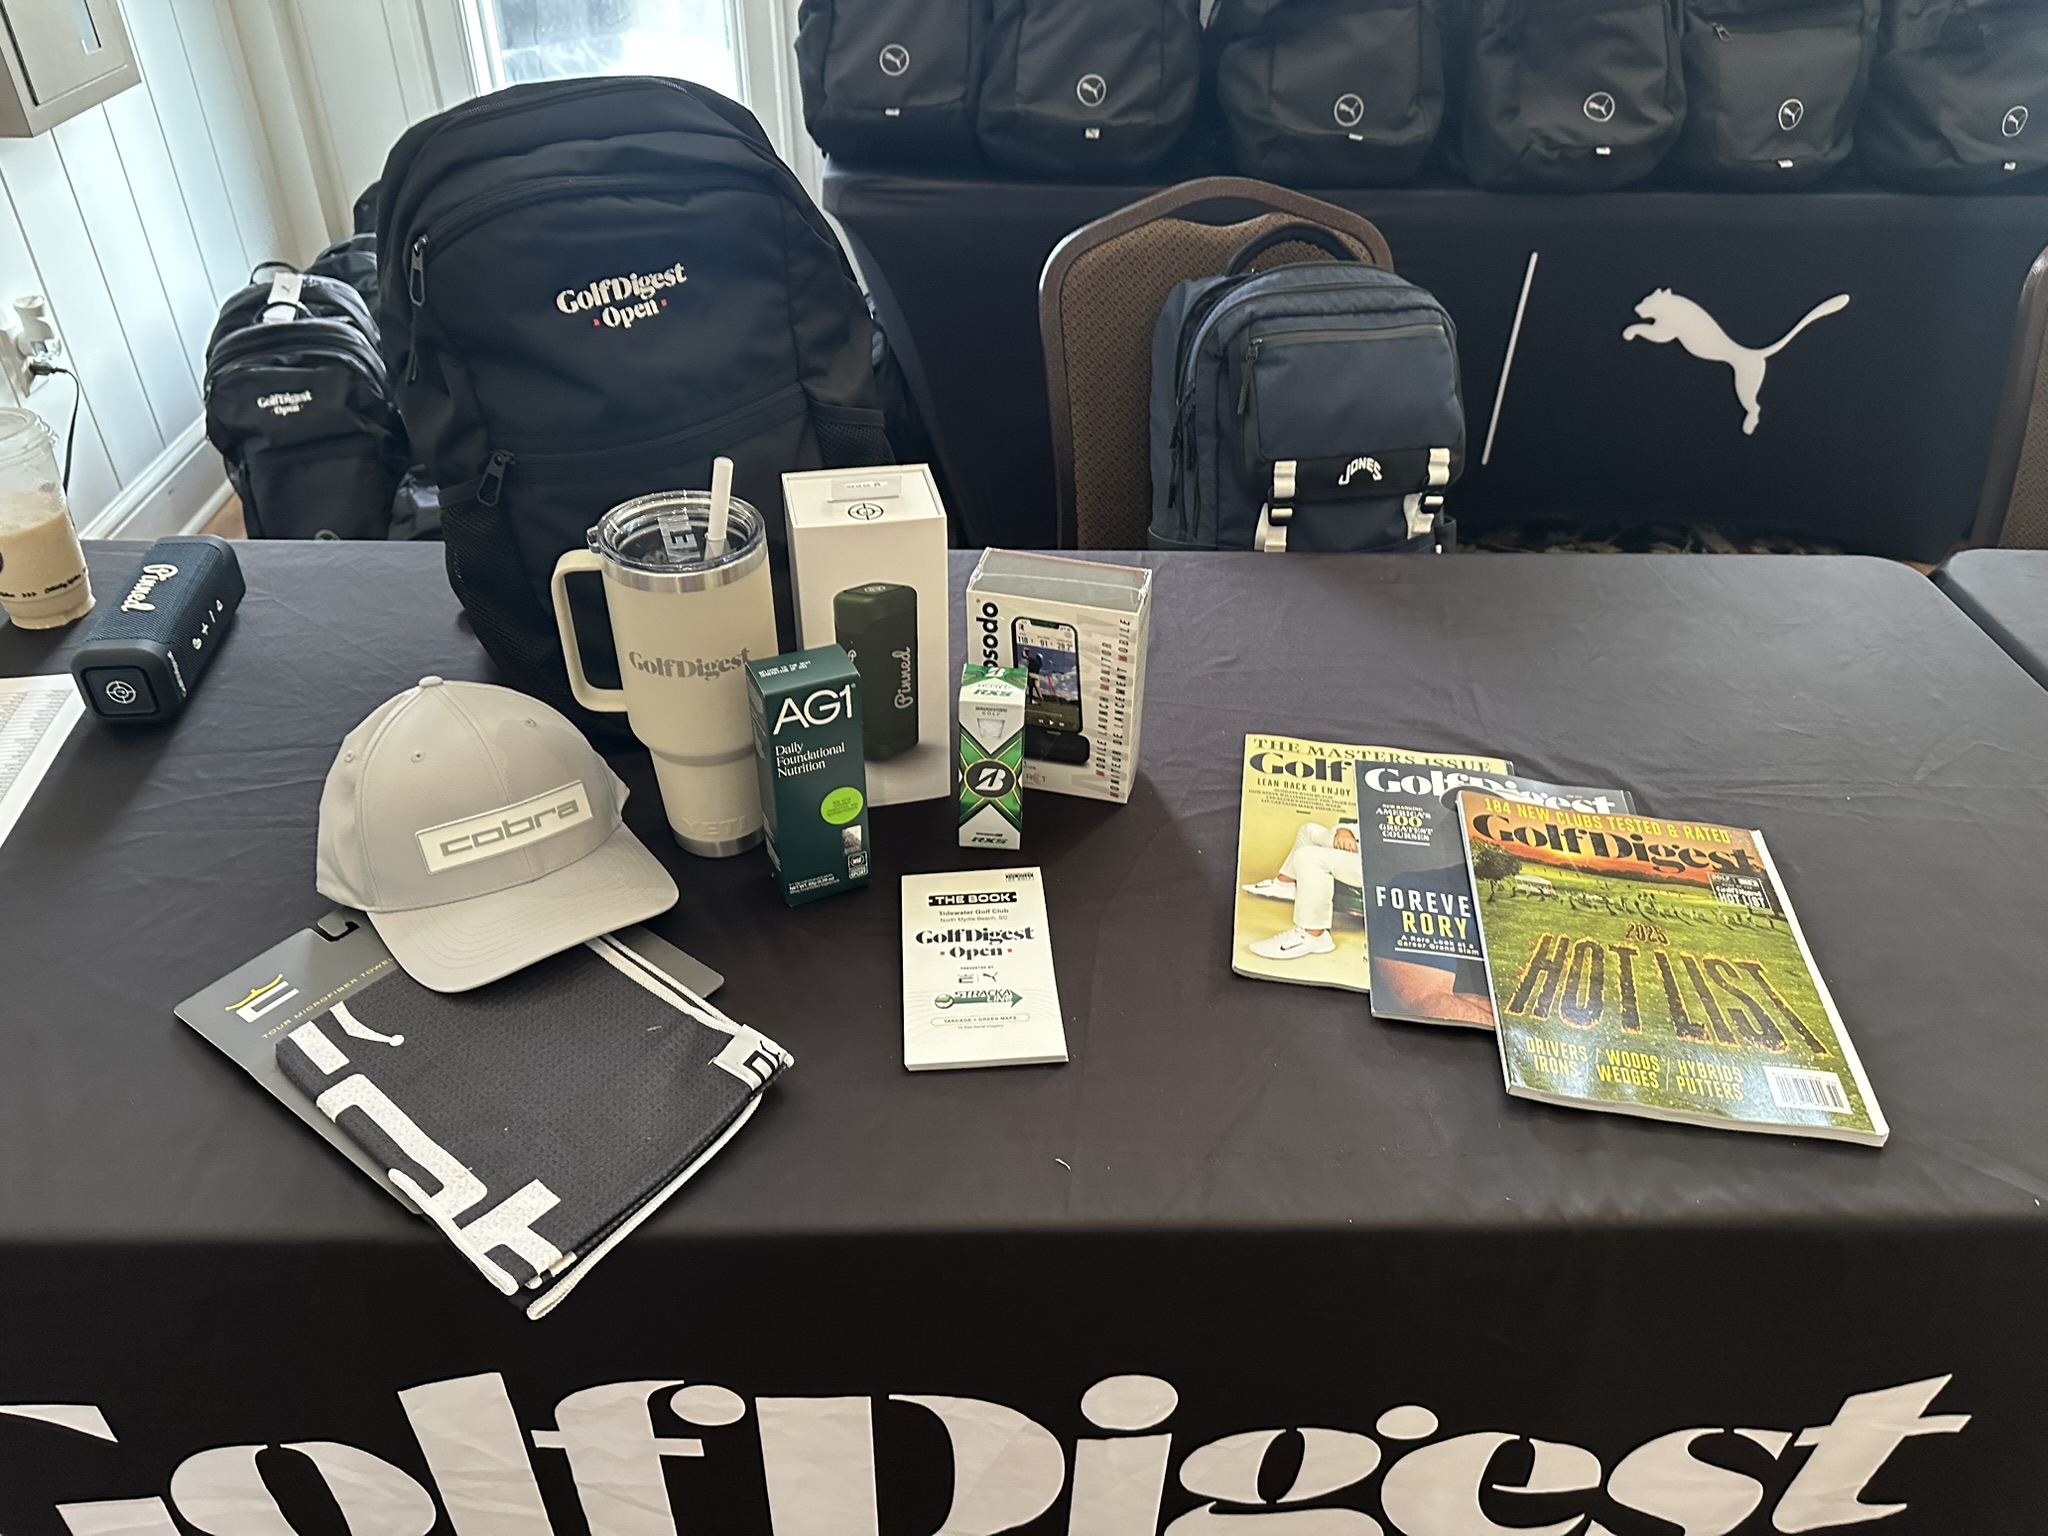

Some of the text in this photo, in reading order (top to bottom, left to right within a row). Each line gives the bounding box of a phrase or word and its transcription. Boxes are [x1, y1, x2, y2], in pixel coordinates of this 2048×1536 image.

[556, 262, 687, 314] GolfDigest
[602, 299, 659, 328] Open
[257, 390, 312, 408] GolfDigest
[274, 405, 300, 416] Open
[1338, 457, 1382, 485] JONES
[121, 564, 178, 612] Pinned
[628, 647, 750, 681] GolfDigest
[894, 647, 913, 709] Pinned
[773, 684, 852, 735] AG1
[1096, 642, 1112, 777] MOBILE LAUNCH MONITOR
[1110, 619, 1130, 798] MONITEUR DE LANCEMENT MOBILE
[775, 742, 803, 756] Daily
[776, 742, 845, 767] Foundational
[1254, 738, 1492, 773] THE MASTERS ISSUE
[778, 760, 826, 778] Nutrition
[1257, 777, 1280, 788] LEAN
[1283, 780, 1307, 792] BACK
[1321, 785, 1351, 797] ENJOY
[682, 815, 746, 837] YETI
[1376, 807, 1431, 819] AMERICA'S
[1386, 815, 1422, 828] 100
[1484, 798, 1731, 844] 184 NEW CLUBS TESTED & RATED
[440, 799, 579, 857] cobra
[1379, 823, 1433, 836] GREATEST
[1382, 830, 1430, 841] COURSES
[1473, 814, 1754, 873] GolfDigest
[935, 893, 1011, 904] THE BOOK
[1376, 886, 1472, 918] FOREVE
[1718, 892, 1765, 908] HOT LIST
[915, 927, 1035, 945] GolfDigest
[1402, 911, 1468, 940] RORY
[1625, 922, 1670, 945] 2025
[949, 946, 1003, 960] Open
[1397, 939, 1480, 956] Career Grand Slam
[1410, 935, 1430, 944] Rare
[1433, 938, 1454, 946] Look
[954, 989, 1011, 999] STRACKA
[1505, 932, 1833, 1058] HOT LIST
[261, 1019, 292, 1039] TOUR
[294, 977, 358, 1019] MICROFIBER
[1526, 1036, 1744, 1083] DRIVERS WOODS HYBRIDS
[1534, 1054, 1743, 1100] IRONS WEDGES PUTTERS
